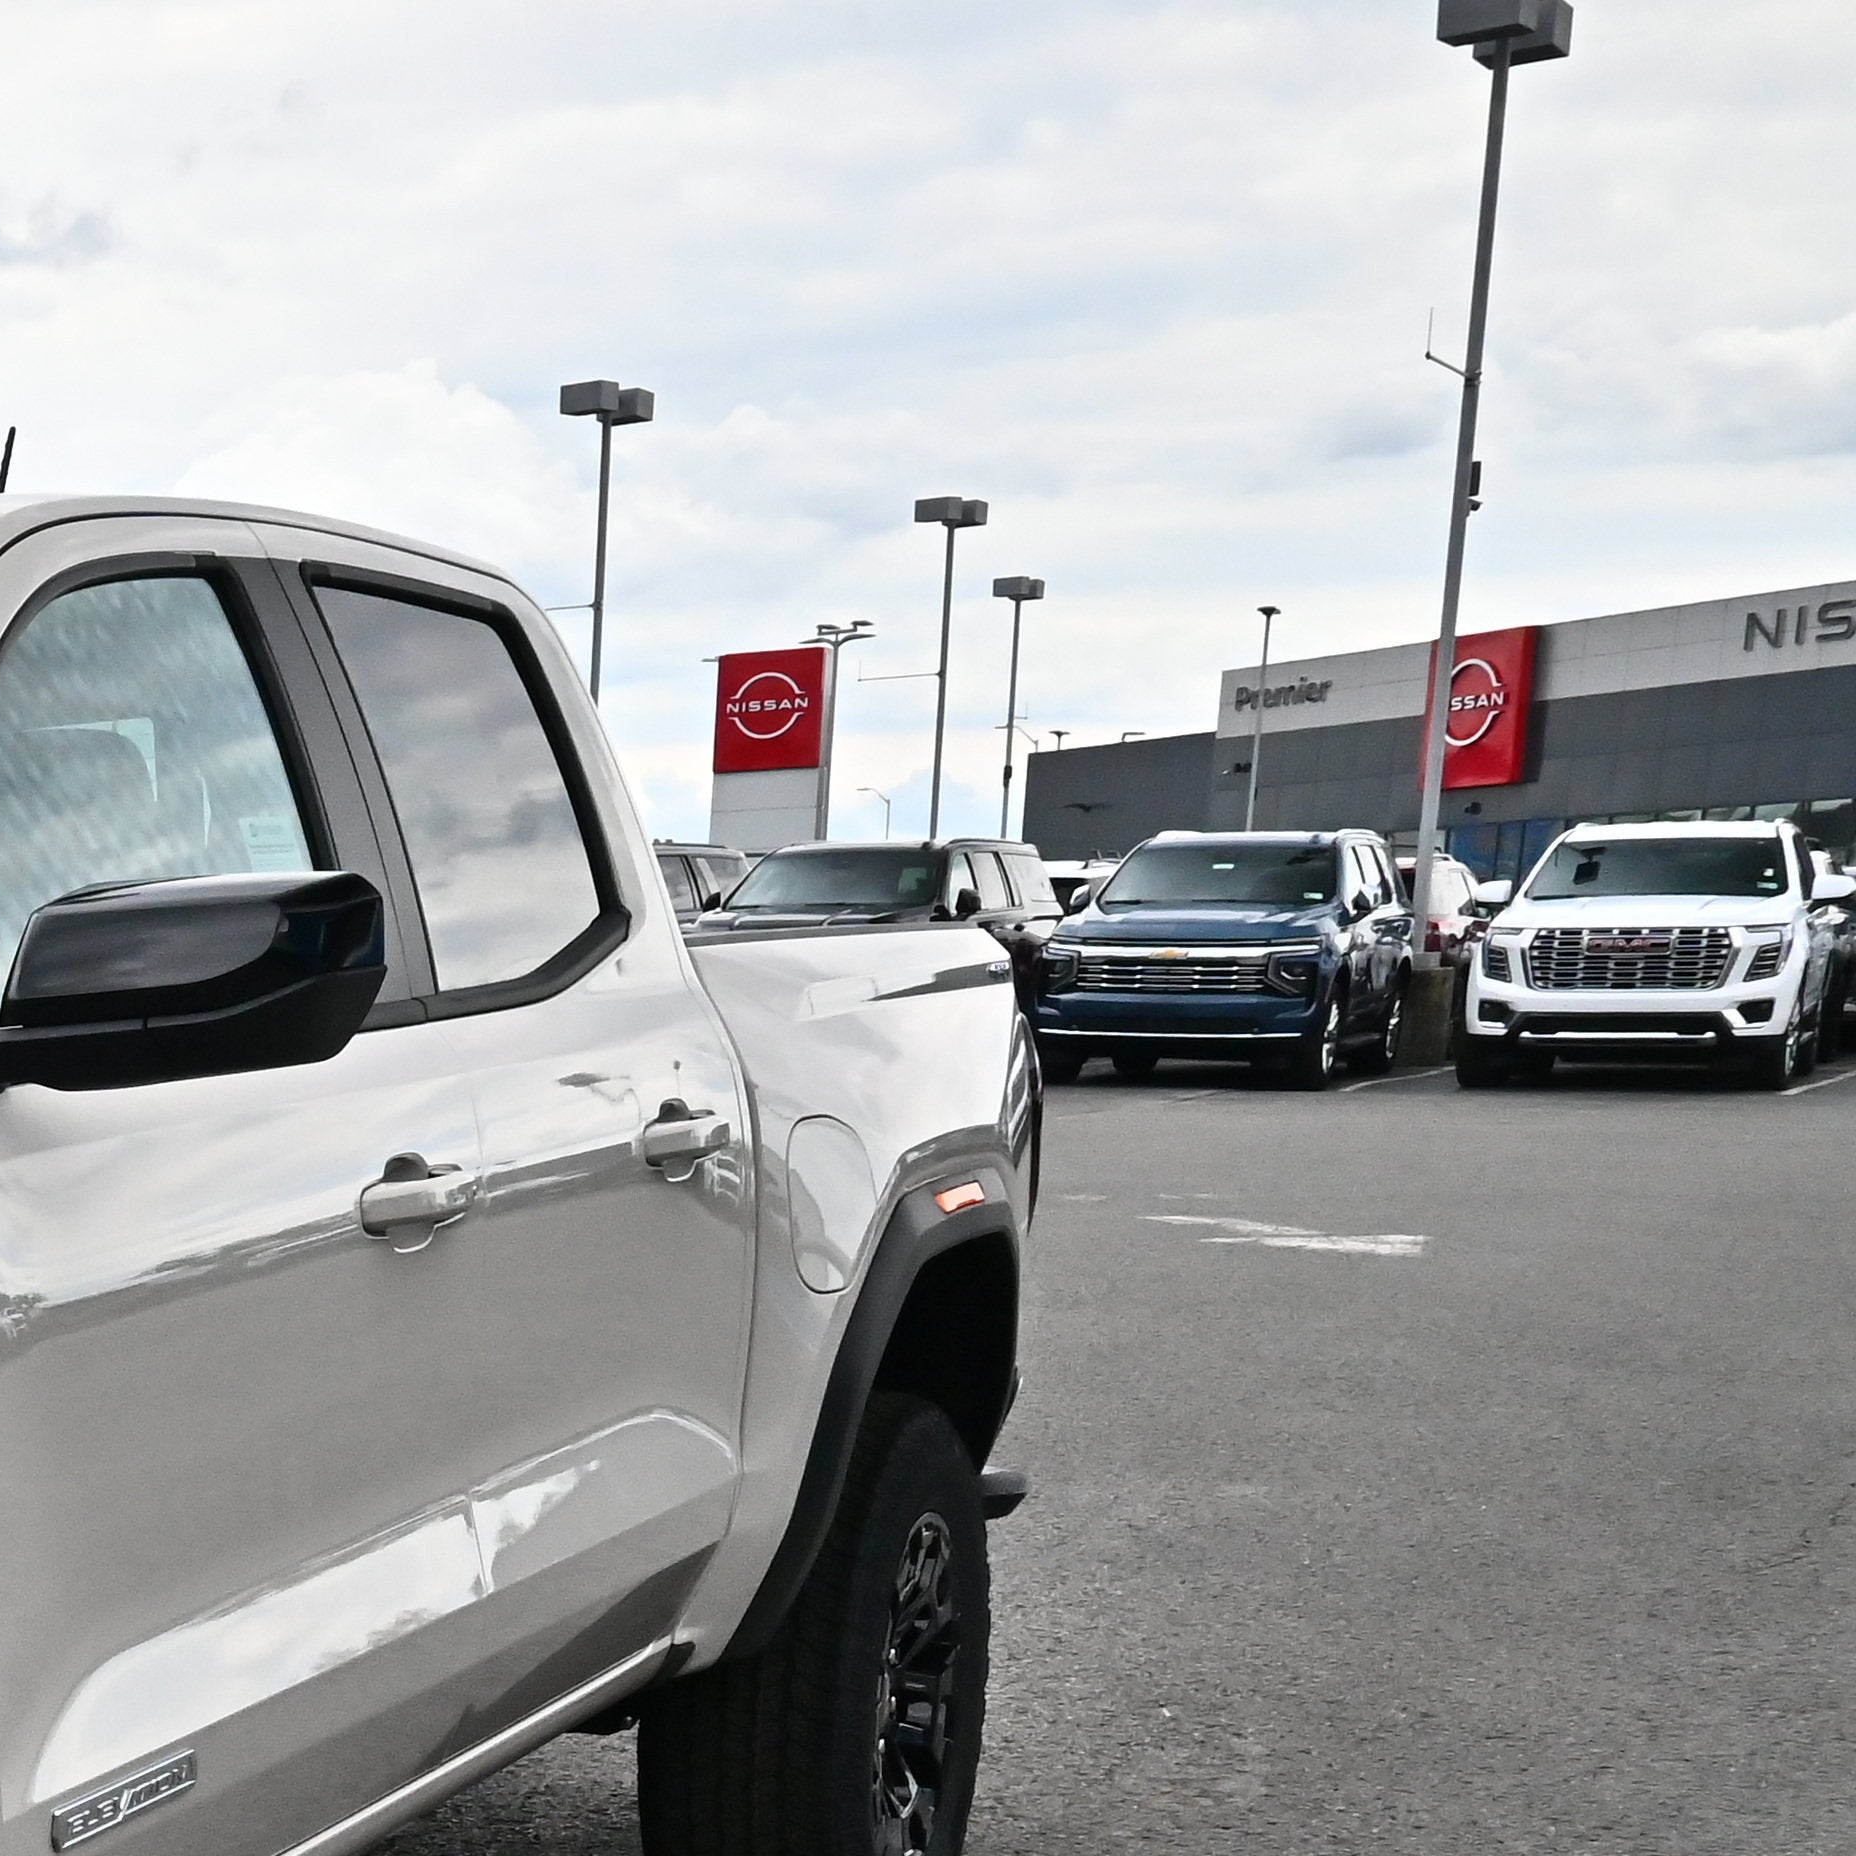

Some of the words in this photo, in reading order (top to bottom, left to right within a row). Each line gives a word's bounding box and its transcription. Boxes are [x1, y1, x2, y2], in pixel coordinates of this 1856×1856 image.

[1235, 676, 1333, 711] Premier
[1450, 691, 1504, 711] SSAN
[726, 697, 808, 714] NISSAN
